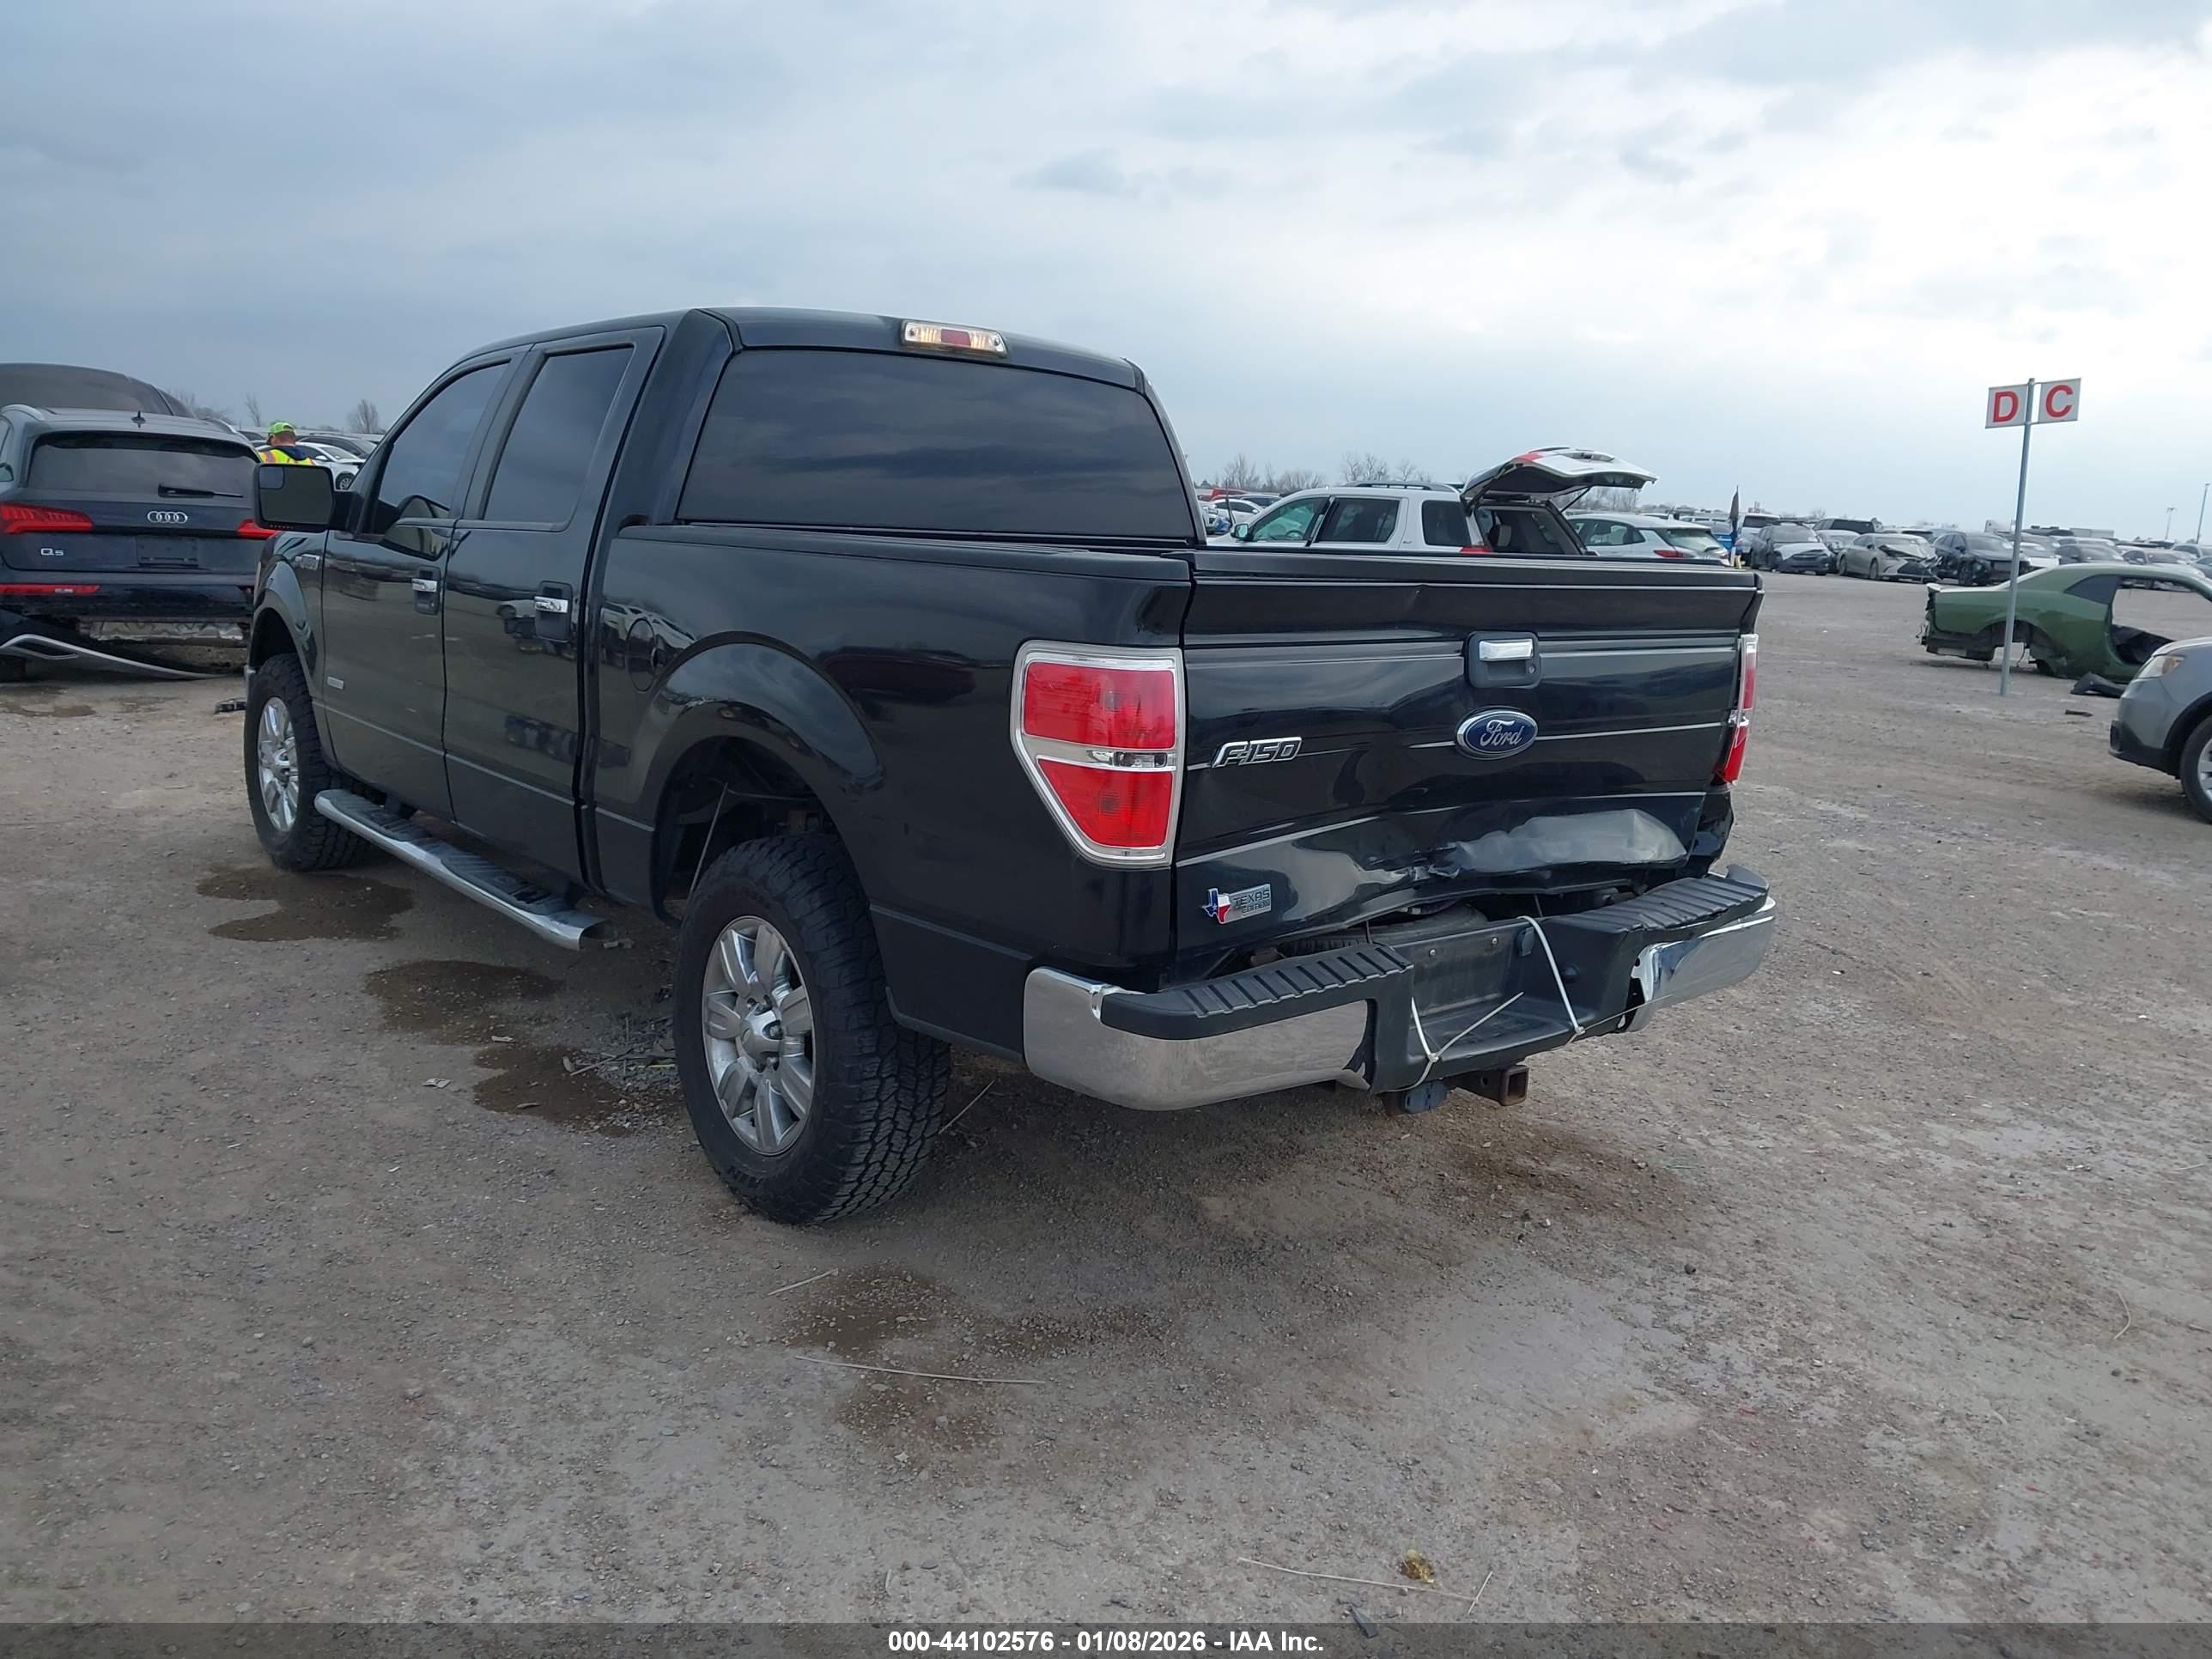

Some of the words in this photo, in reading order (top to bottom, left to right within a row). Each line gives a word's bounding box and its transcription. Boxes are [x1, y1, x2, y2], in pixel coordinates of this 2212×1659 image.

[1992, 391, 2019, 422] D
[2045, 385, 2074, 418] C
[40, 548, 64, 556] Q5
[1480, 717, 1525, 747] Ford
[1212, 736, 1303, 769] F-150
[1233, 890, 1270, 907] TEXAS
[1243, 902, 1270, 914] EDITION
